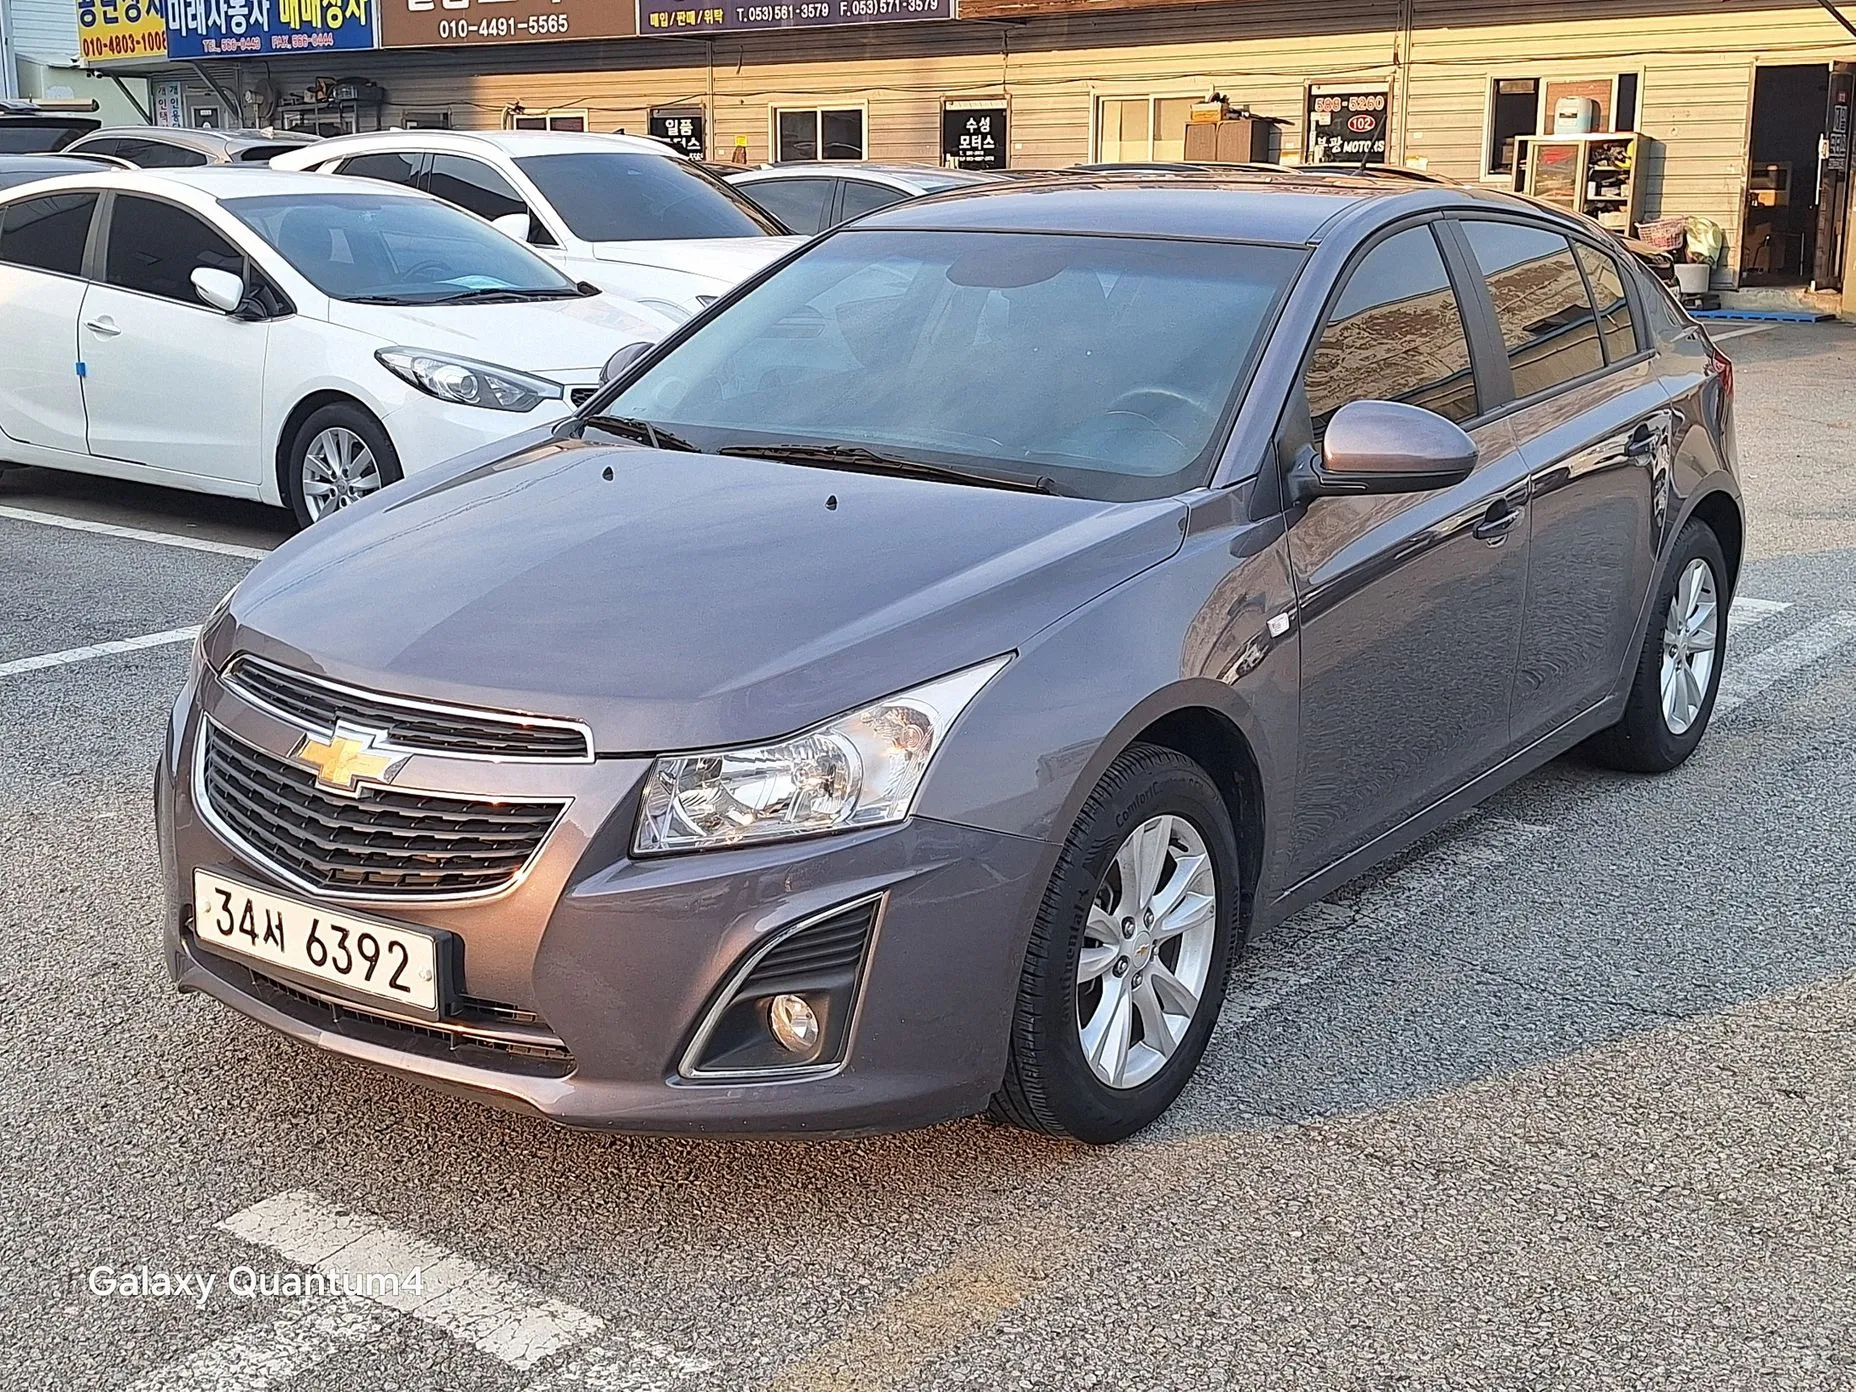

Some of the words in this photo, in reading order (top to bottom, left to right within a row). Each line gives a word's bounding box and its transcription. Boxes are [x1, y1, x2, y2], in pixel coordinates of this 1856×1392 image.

[439, 14, 568, 38] 010-4491-5565
[665, 119, 694, 136] 일품
[966, 116, 991, 134] 수성
[1353, 118, 1372, 130] 102
[959, 134, 995, 151] 모터스
[214, 886, 286, 953] 34서
[306, 918, 411, 993] 6392
